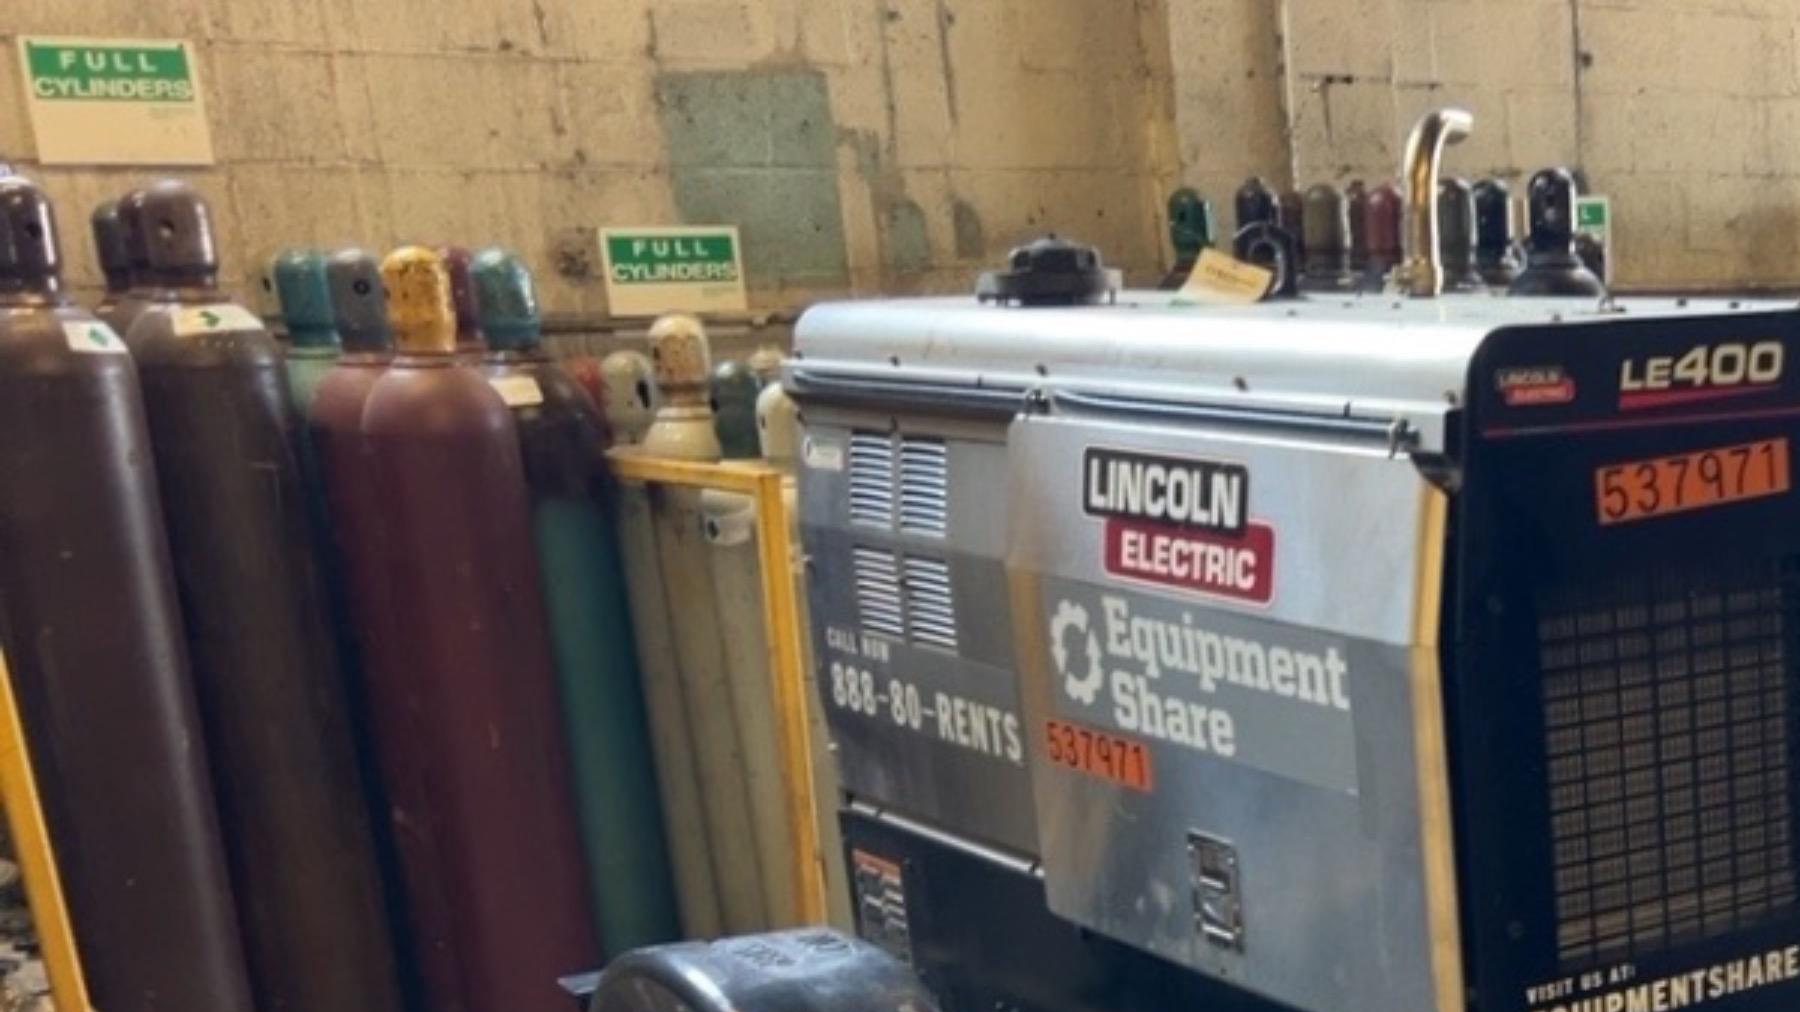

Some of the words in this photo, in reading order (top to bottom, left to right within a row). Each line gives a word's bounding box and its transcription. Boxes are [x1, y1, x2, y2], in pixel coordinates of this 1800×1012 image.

[35, 76, 194, 98] CYLINDERS
[59, 50, 158, 73] FULL
[613, 262, 738, 281] CYLINDERS
[632, 239, 709, 258] FULL
[1619, 341, 1784, 391] LE400
[1089, 457, 1241, 529] LINCOLN
[1602, 443, 1779, 519] 537971
[1120, 529, 1257, 591] ELECTRIC
[825, 625, 858, 656] CALL
[1102, 595, 1351, 712] Equipment
[830, 661, 1024, 766] 888-80-RENTS
[1110, 669, 1237, 758] Share
[1046, 721, 1145, 786] 537971
[1525, 976, 1574, 1004] VISIT
[1580, 971, 1603, 992] US
